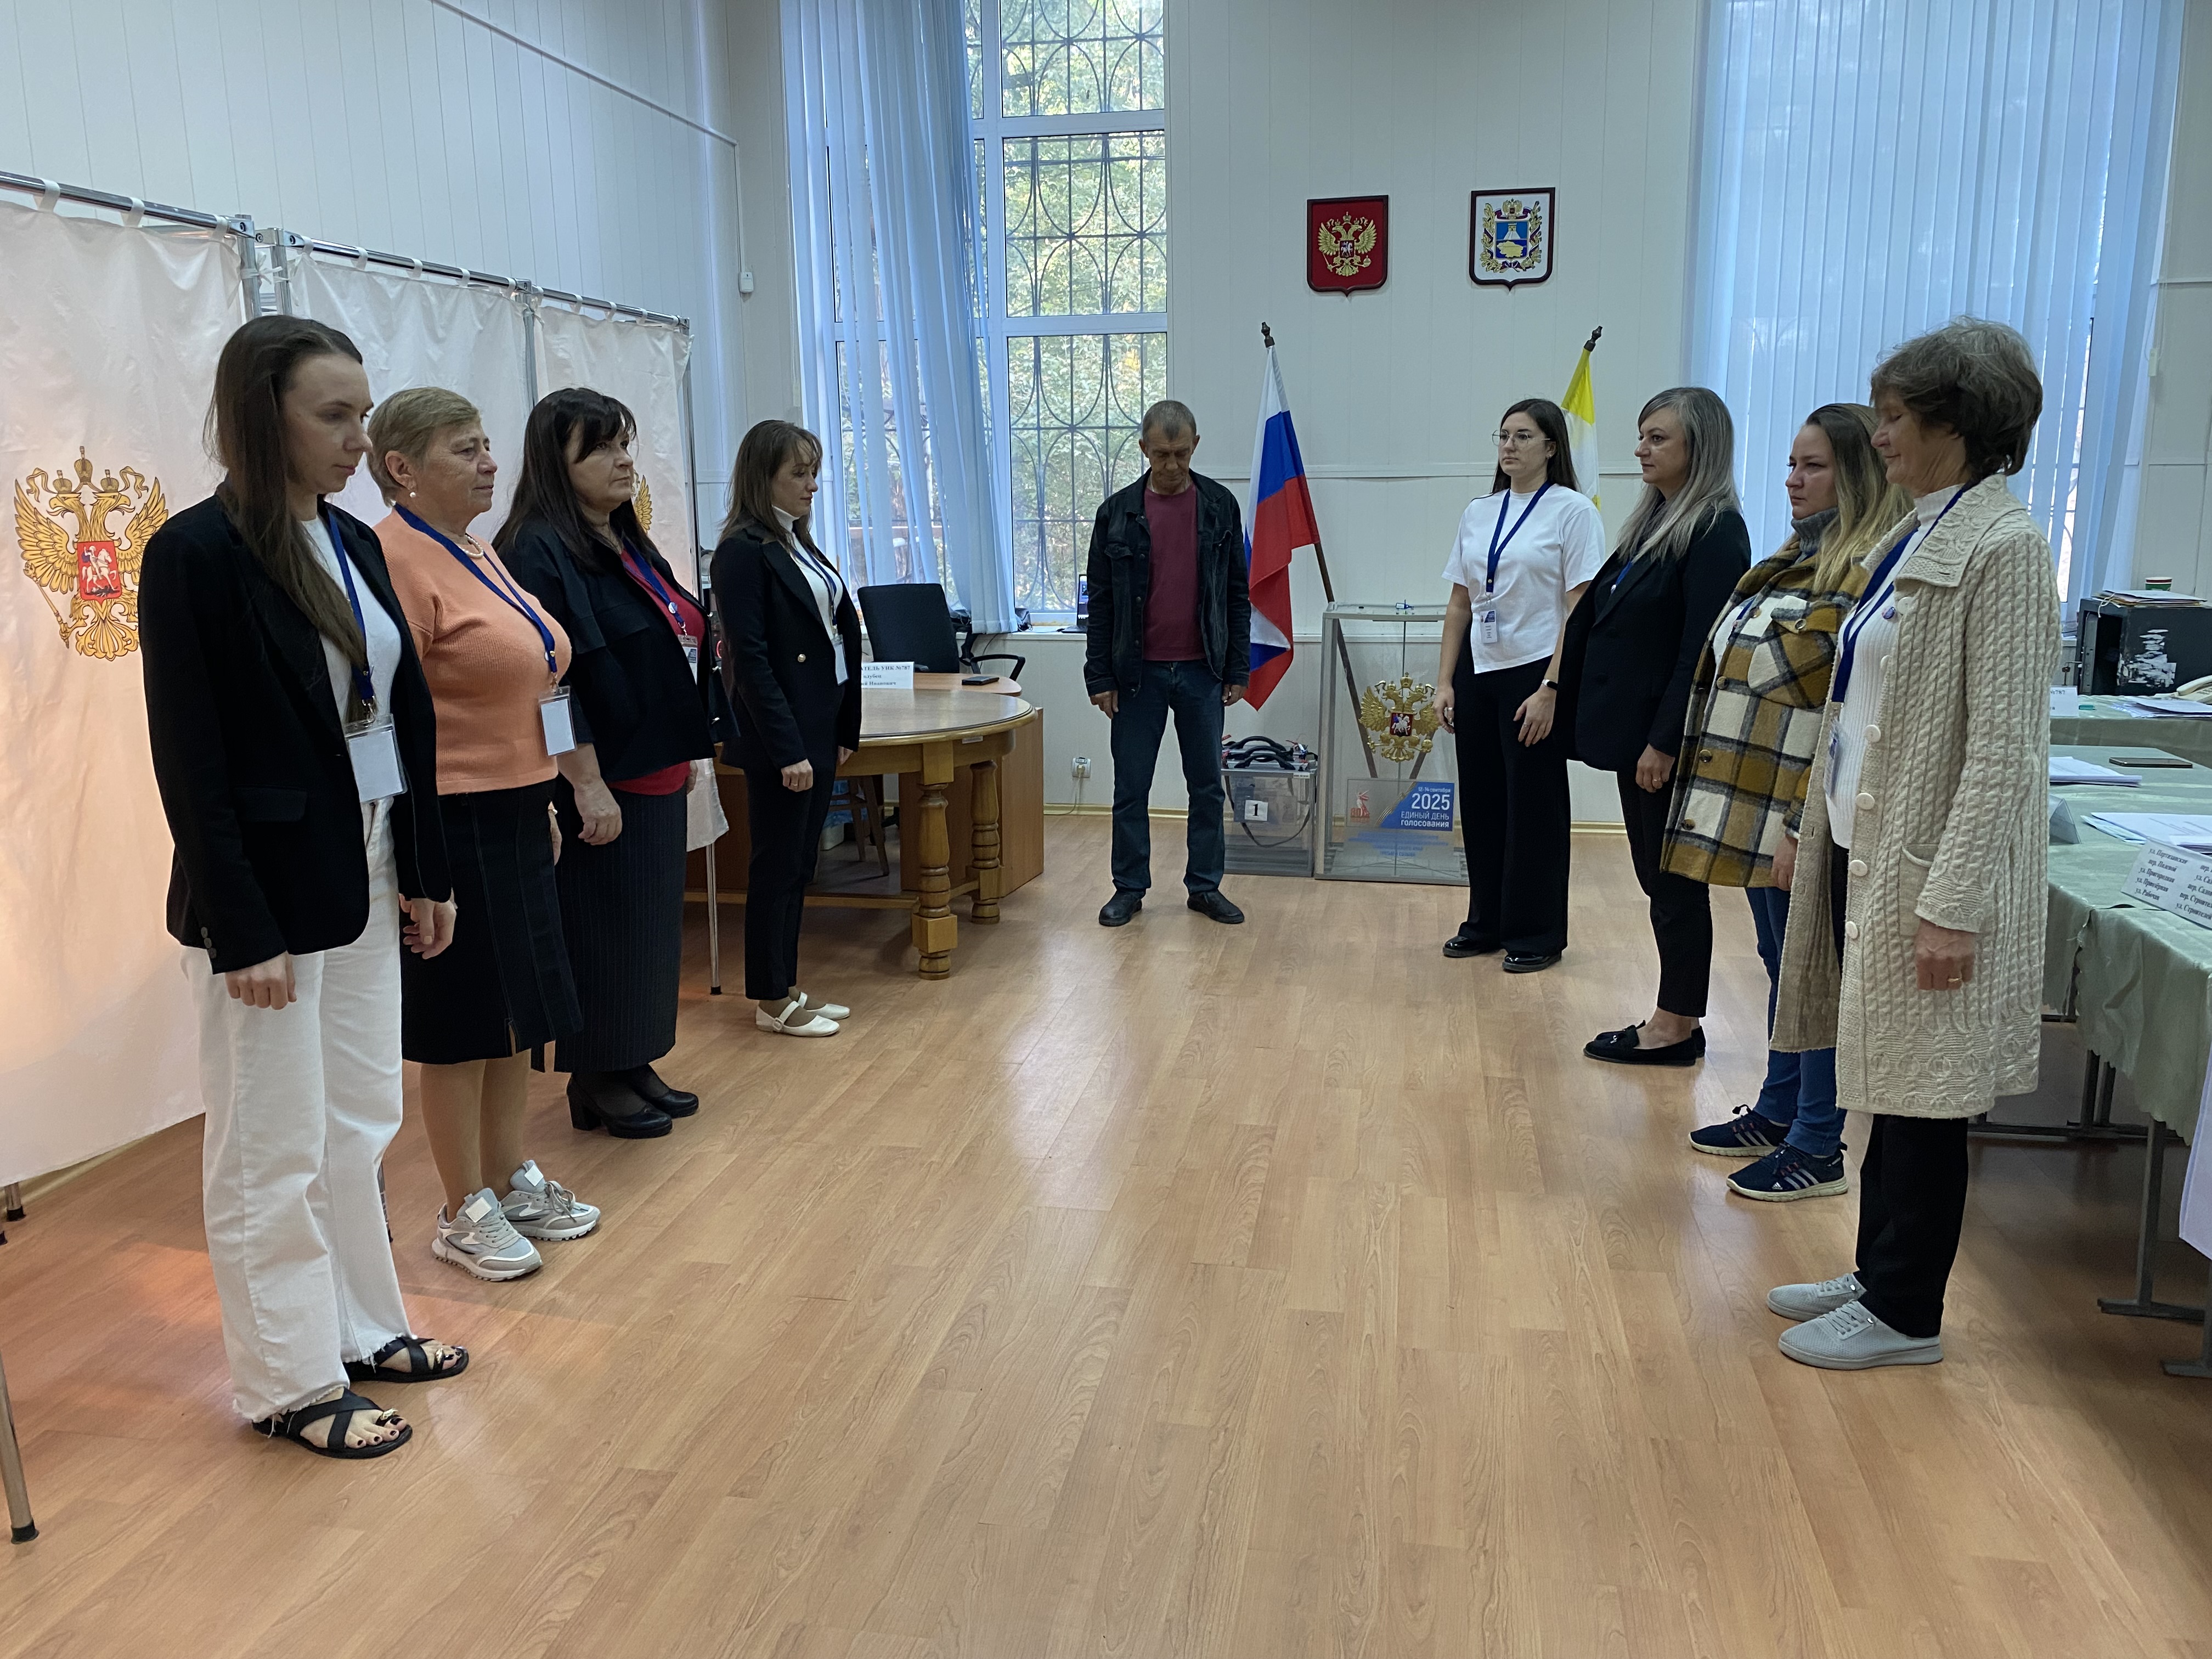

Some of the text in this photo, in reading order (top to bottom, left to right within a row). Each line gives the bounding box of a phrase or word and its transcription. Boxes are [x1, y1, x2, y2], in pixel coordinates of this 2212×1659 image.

[1411, 793, 1450, 811] 2025
[1252, 803, 1260, 817] 1
[1401, 811, 1430, 820] ЕДИНЫЙ
[1401, 820, 1449, 828] голосования
